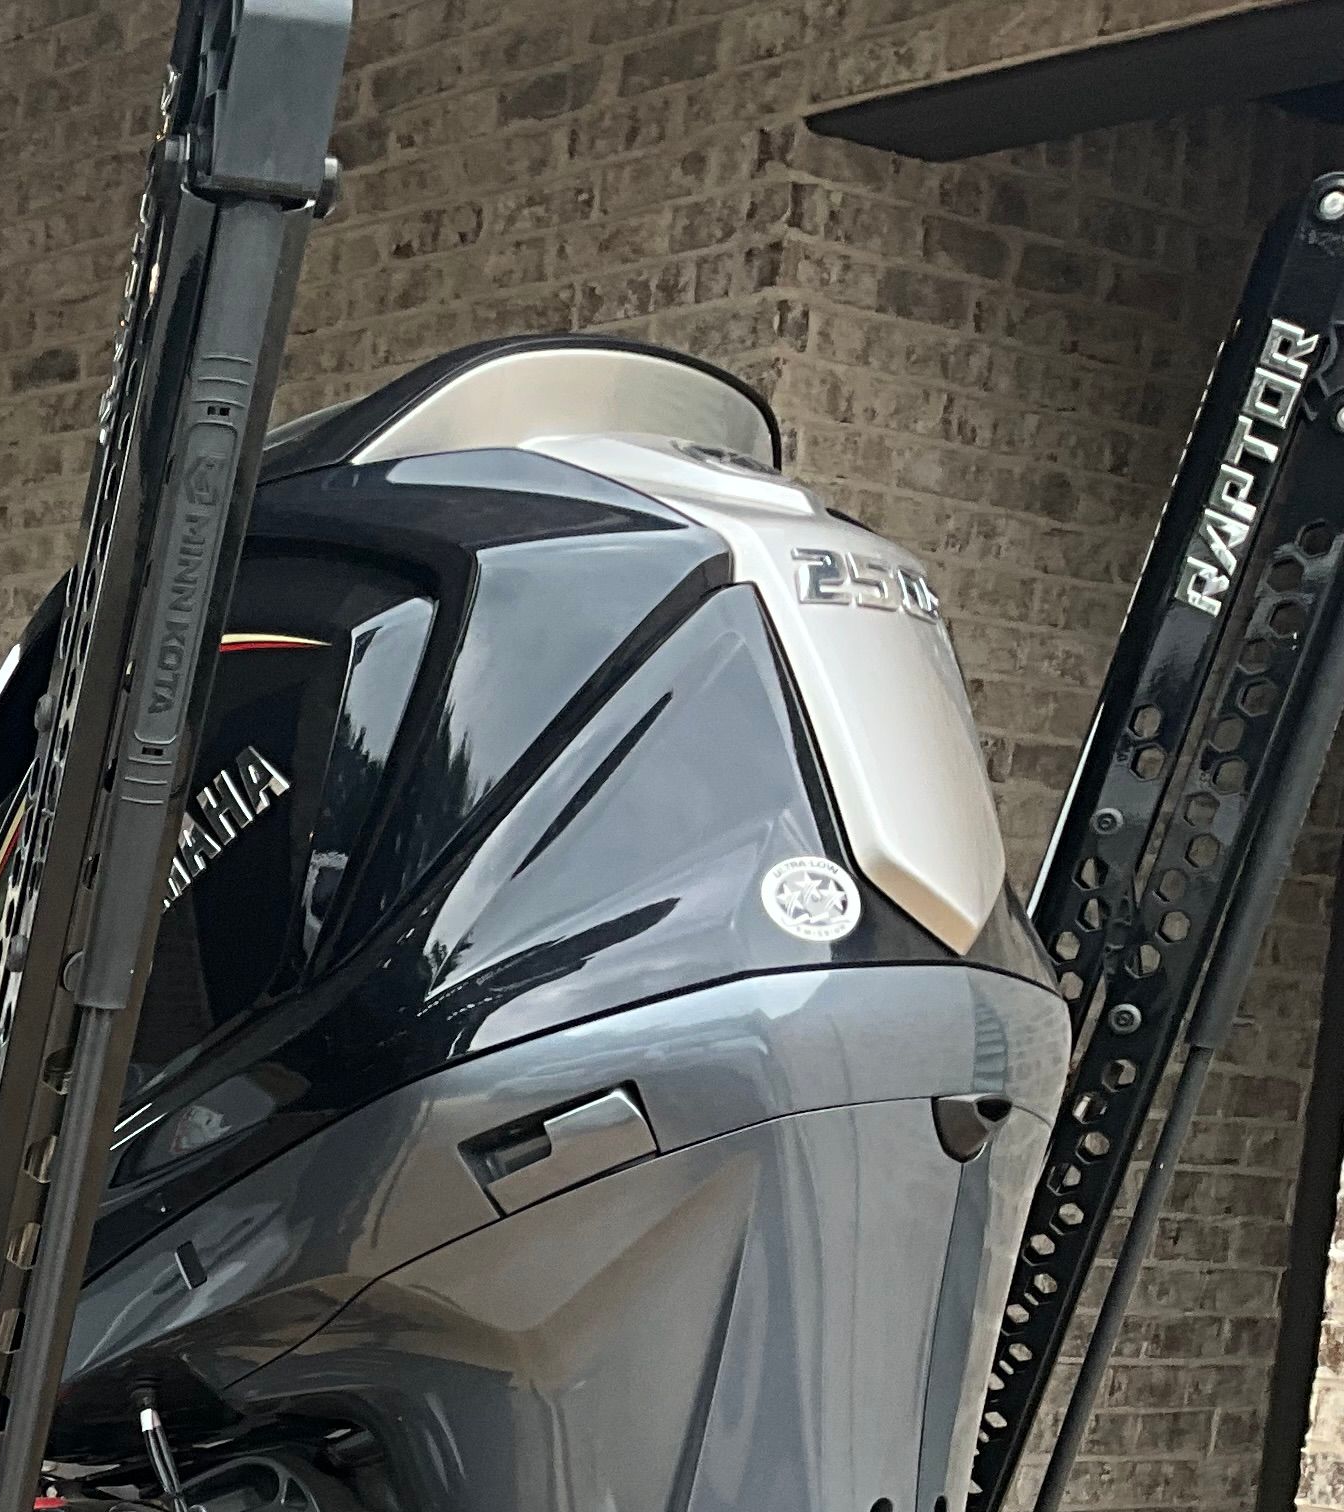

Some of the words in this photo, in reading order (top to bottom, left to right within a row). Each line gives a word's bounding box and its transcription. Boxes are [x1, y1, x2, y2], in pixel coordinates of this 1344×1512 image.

[1175, 318, 1319, 619] RAPTOR
[168, 513, 210, 612] MINN
[148, 619, 189, 714] KOTA
[162, 746, 289, 913] MAHA
[774, 861, 806, 877] ULTRA
[810, 861, 838, 874] LOW
